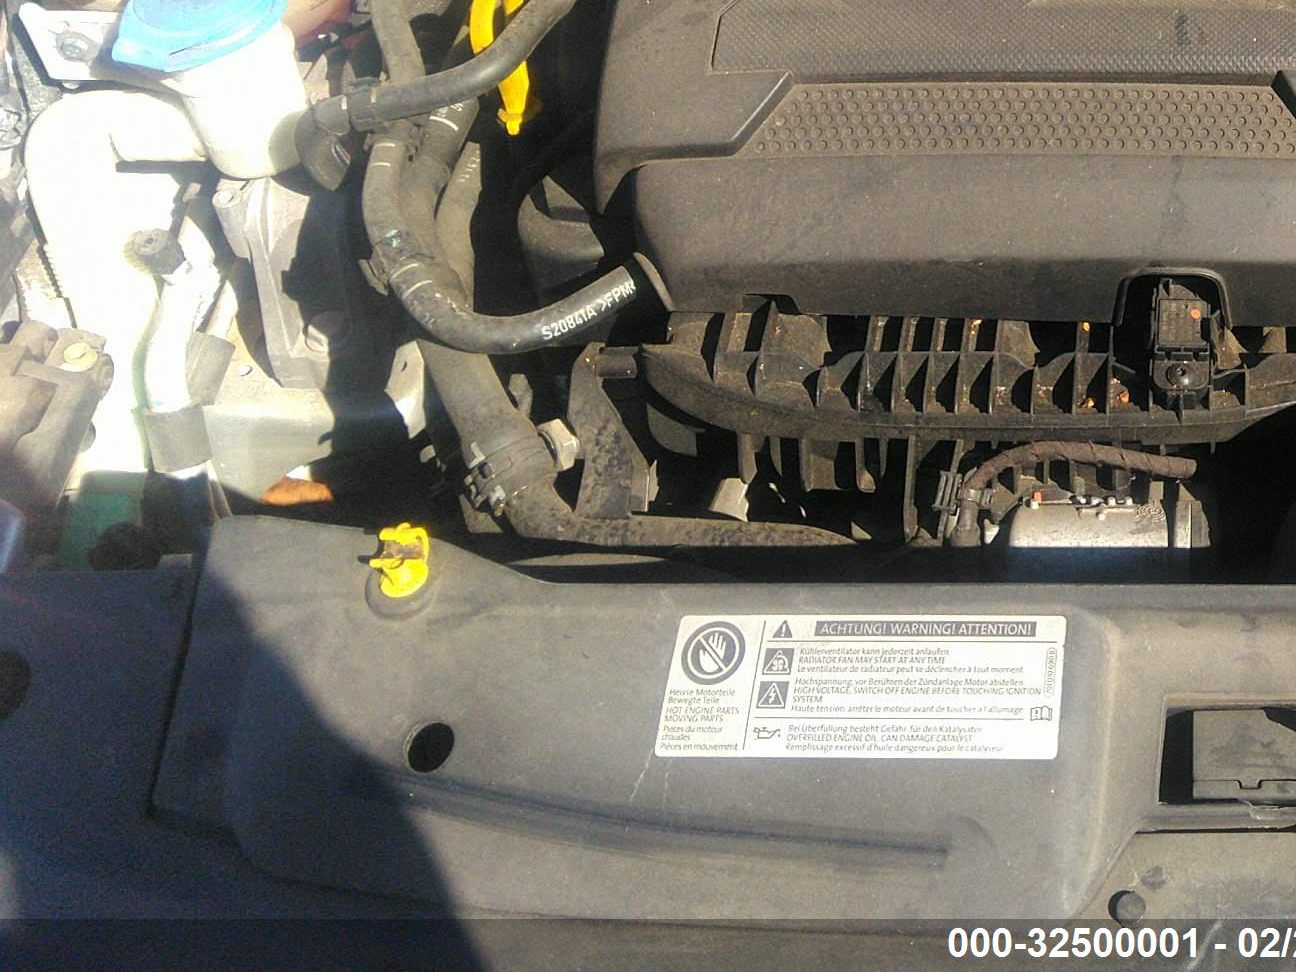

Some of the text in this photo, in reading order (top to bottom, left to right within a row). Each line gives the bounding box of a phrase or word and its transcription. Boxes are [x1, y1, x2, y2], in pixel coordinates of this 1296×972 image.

[820, 623, 1032, 635] ACHTUNG! WARNING! ATTENTION!
[862, 647, 880, 655] kann
[799, 656, 945, 664] RADIATOR FAN MAY START AT ANY TIME
[797, 665, 805, 673] Le
[807, 665, 848, 673] ventilateur
[849, 665, 859, 673] de
[860, 665, 894, 673] radiateur
[855, 678, 867, 686] vor
[904, 678, 917, 686] der
[964, 678, 988, 686] Motor
[669, 688, 736, 696] Heisse Motorteile
[794, 687, 815, 695] HIGH
[854, 687, 883, 695] SWITCH
[884, 687, 900, 695] OFF
[900, 687, 930, 695] ENGINE
[932, 687, 960, 695] BEFORE
[963, 687, 1004, 695] TOUCHING
[1006, 687, 1042, 695] IGNITION
[667, 696, 720, 706] Bewegte Teile
[665, 707, 740, 715] HOT ENGINE PARTS
[791, 705, 815, 713] Haute
[875, 705, 882, 713] le
[883, 705, 911, 713] moteur
[913, 705, 934, 713] avant
[935, 705, 945, 713] de
[788, 724, 800, 732] Bei
[849, 724, 879, 732] besteht
[880, 724, 907, 732] Gefahr
[923, 724, 937, 732] den
[786, 734, 832, 742] OVERFILLED
[833, 734, 863, 742] ENGINE
[880, 734, 898, 742] CAN
[899, 734, 934, 742] DAMAGE
[935, 734, 972, 742] CATALYST
[683, 742, 692, 750] en
[785, 742, 834, 753] Remplissage
[835, 743, 865, 751] excessif
[937, 745, 955, 753] pour
